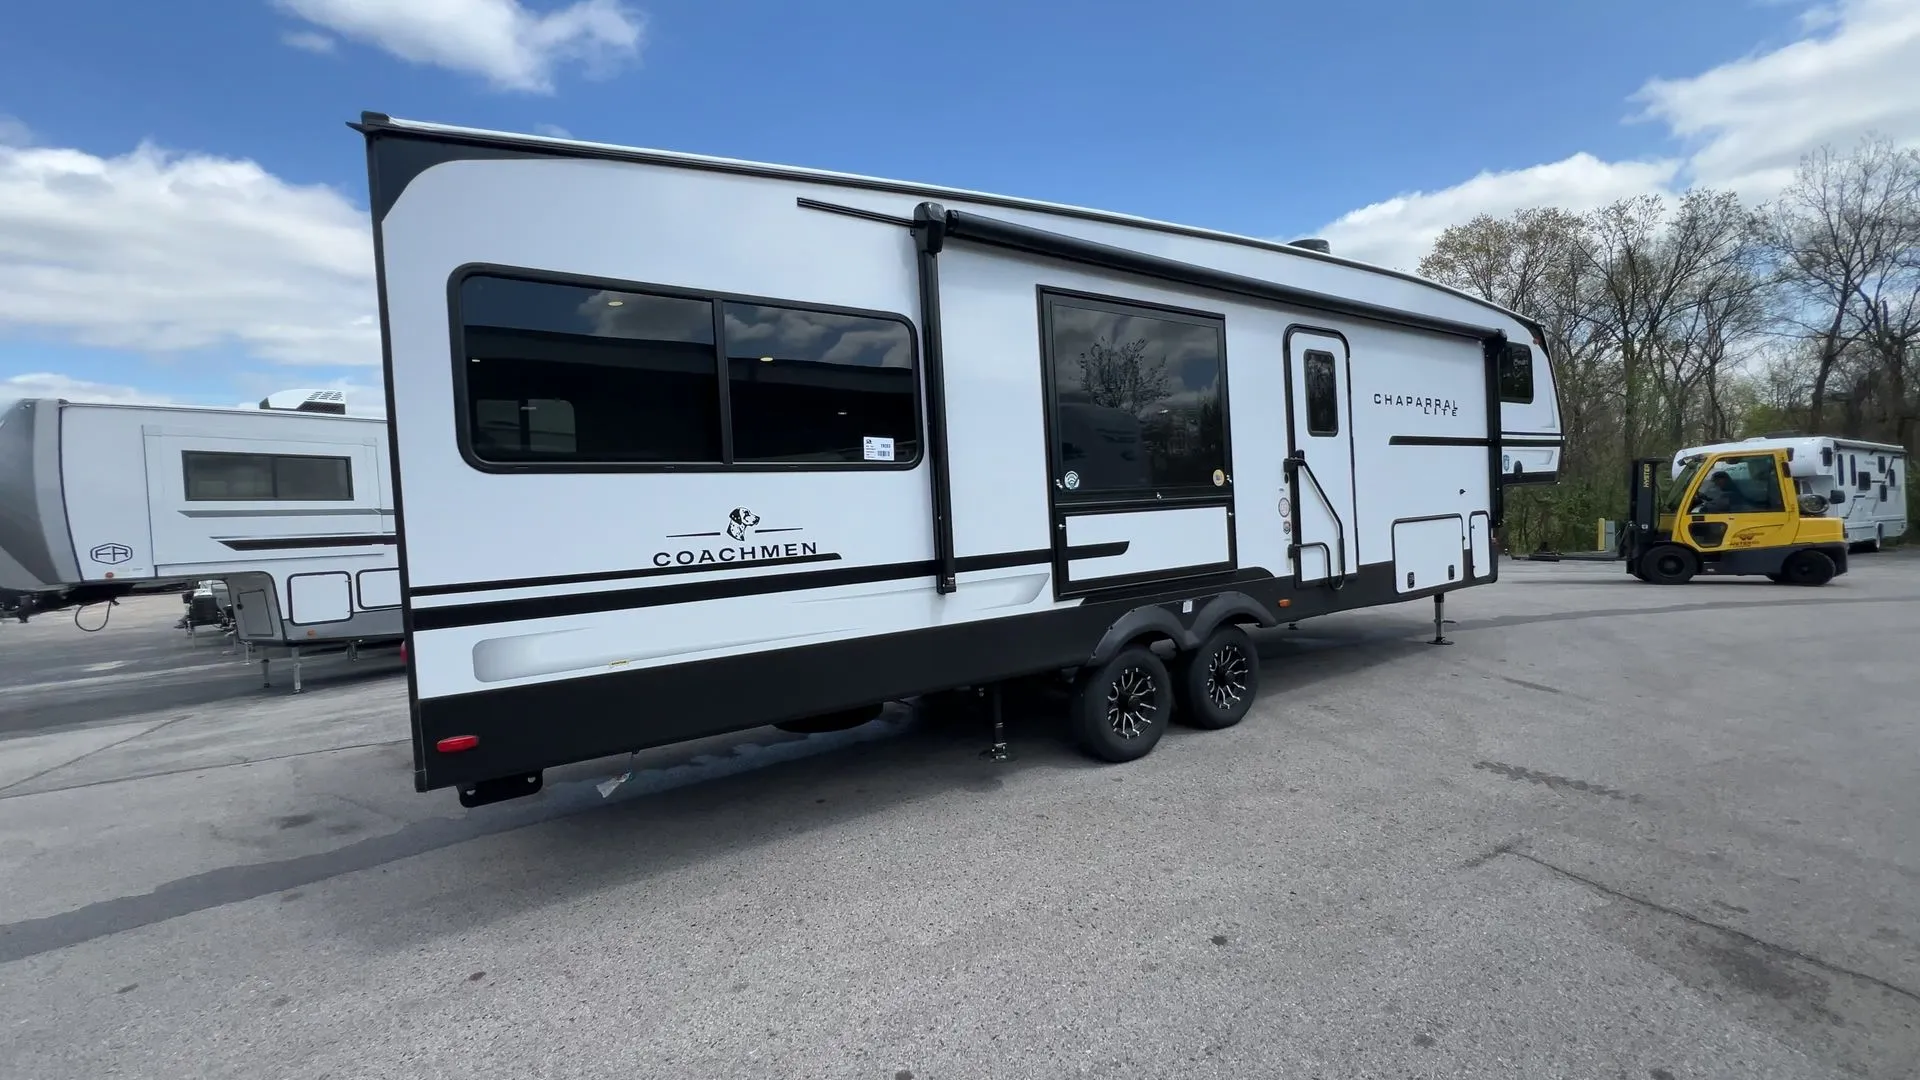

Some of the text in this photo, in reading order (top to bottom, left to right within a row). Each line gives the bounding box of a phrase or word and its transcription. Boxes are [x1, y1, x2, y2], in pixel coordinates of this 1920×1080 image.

[1373, 393, 1458, 410] CHAPARRAL
[1423, 406, 1458, 417] LITE
[1643, 463, 1651, 488] HYSTER
[652, 541, 817, 567] COACHMEN
